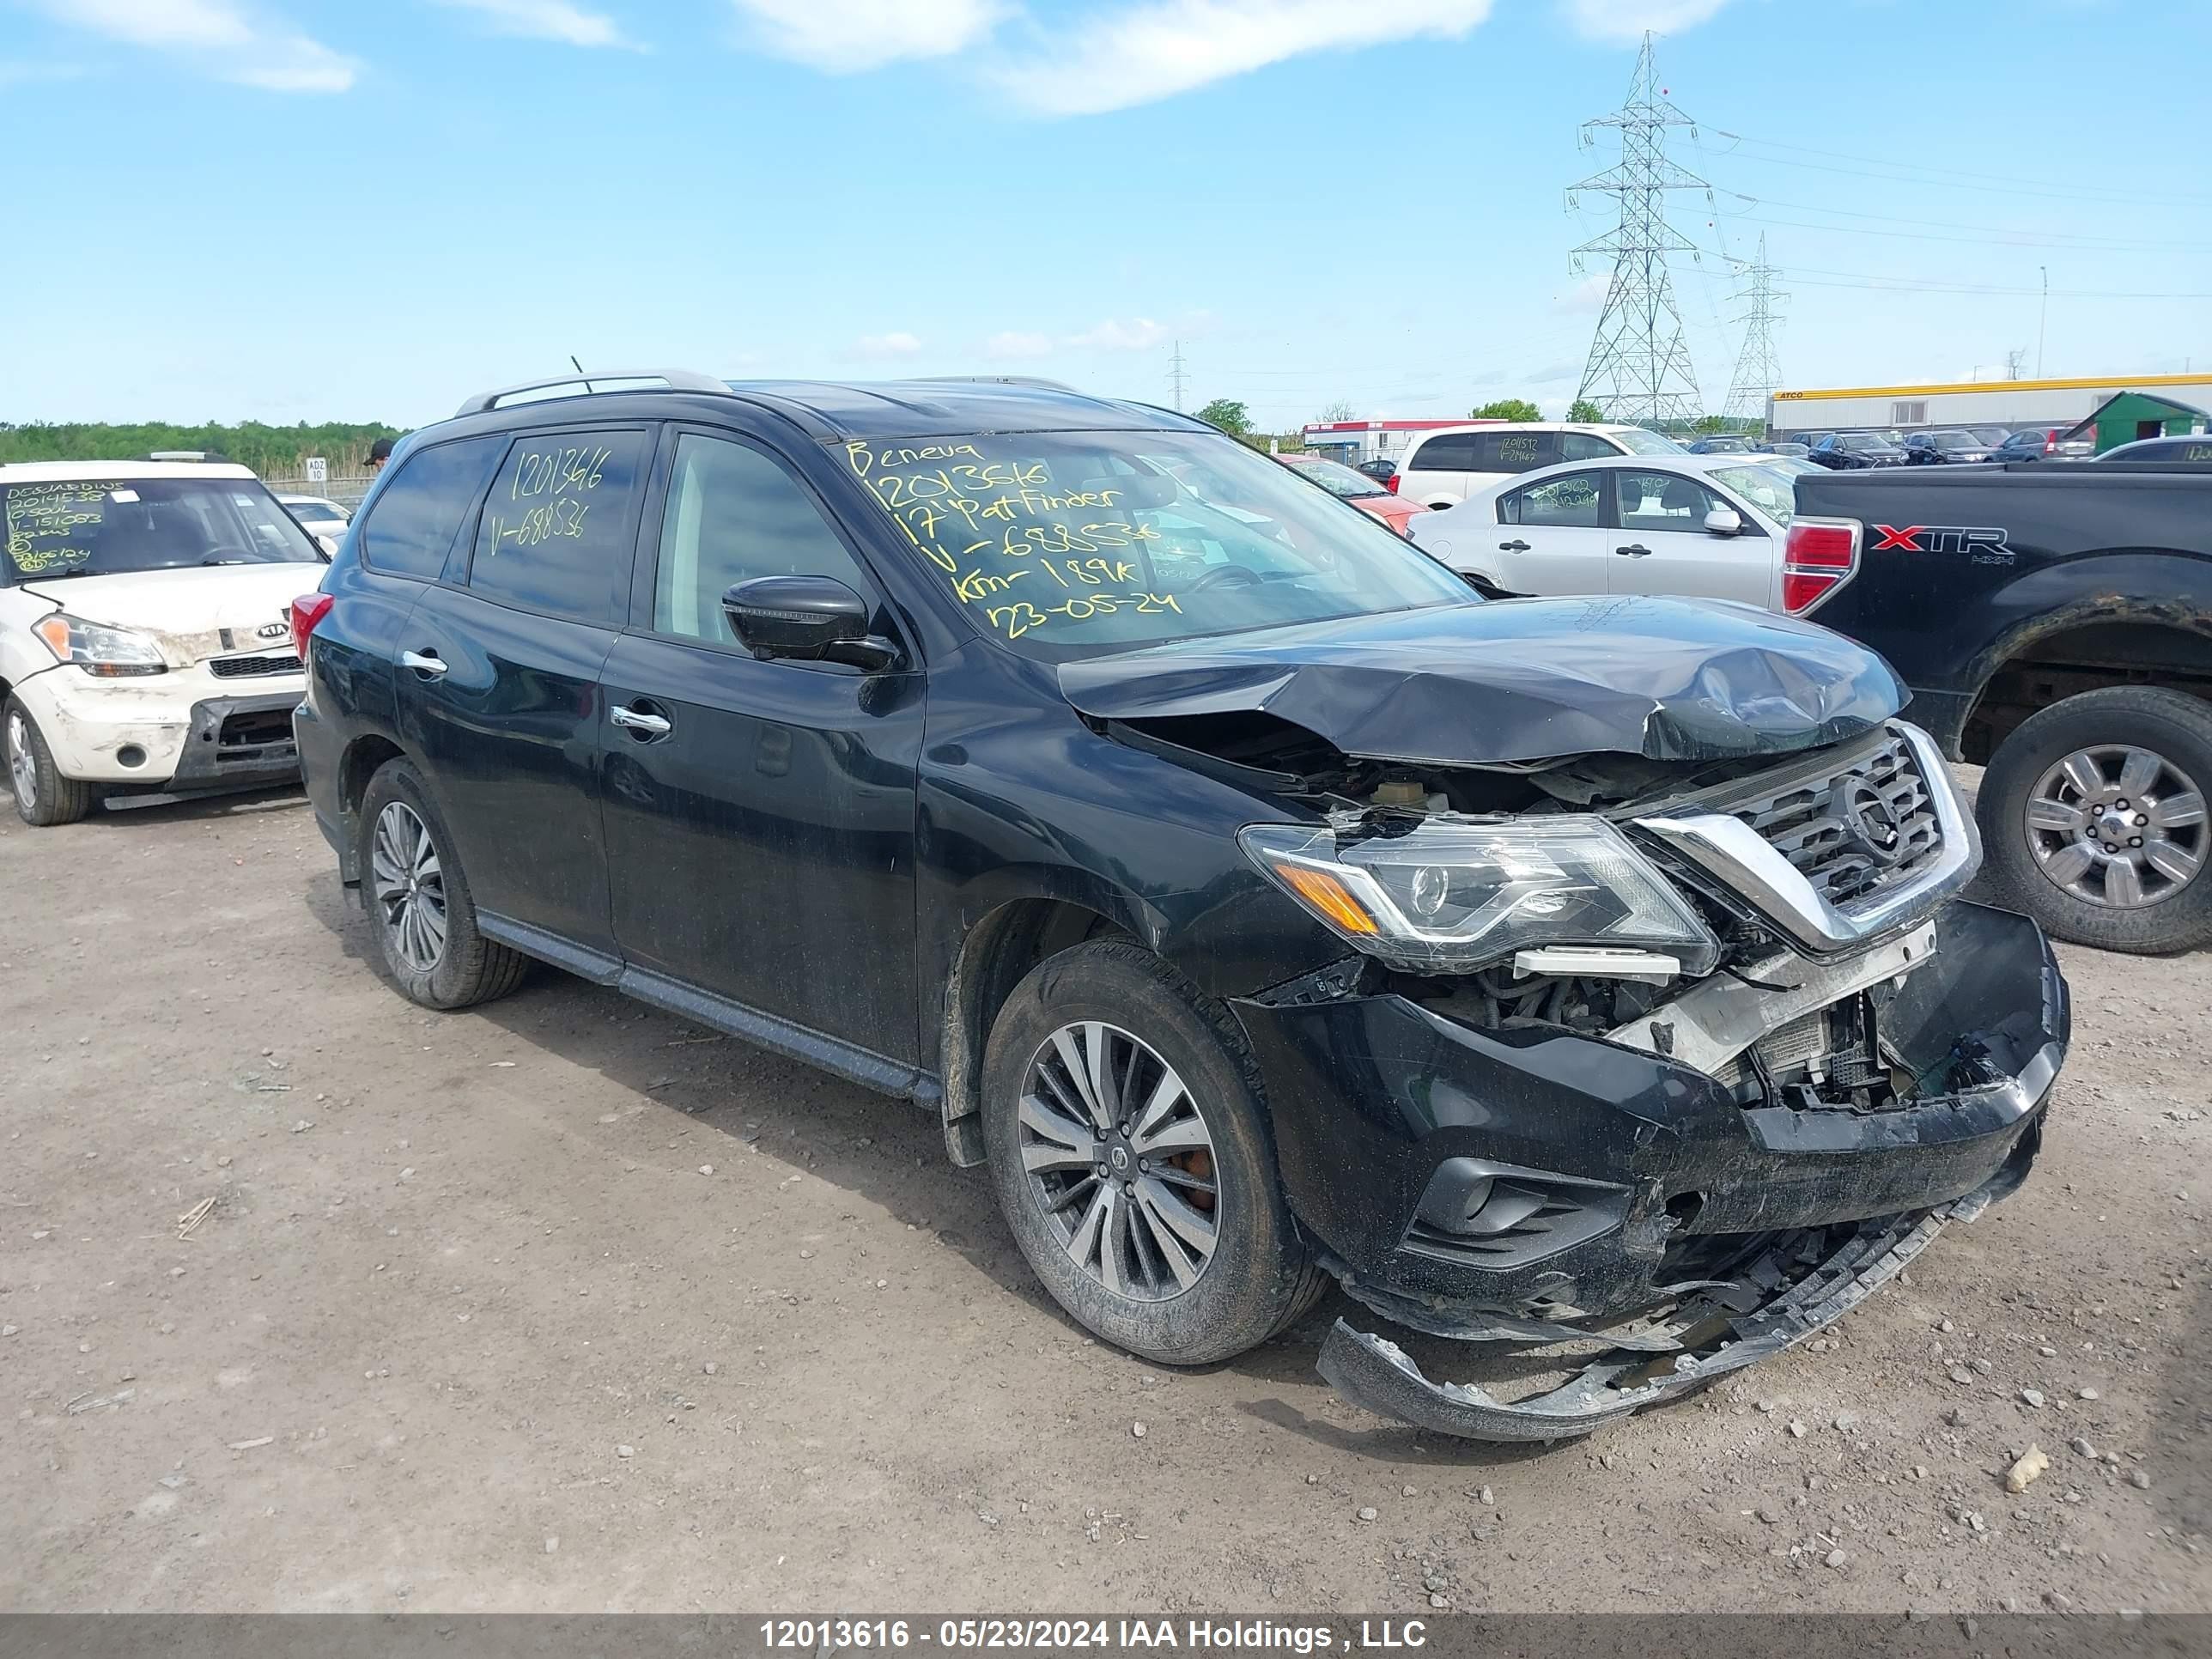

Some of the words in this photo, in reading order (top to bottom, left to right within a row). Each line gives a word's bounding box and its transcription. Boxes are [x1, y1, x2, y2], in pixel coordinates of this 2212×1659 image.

[313, 470, 322, 479] 10
[513, 446, 612, 501] 12013616
[845, 441, 986, 477] Beneva
[863, 462, 1048, 512] 12013616
[27, 504, 73, 517] SOUL
[1870, 524, 2016, 555] XTR
[260, 624, 287, 636] KIA
